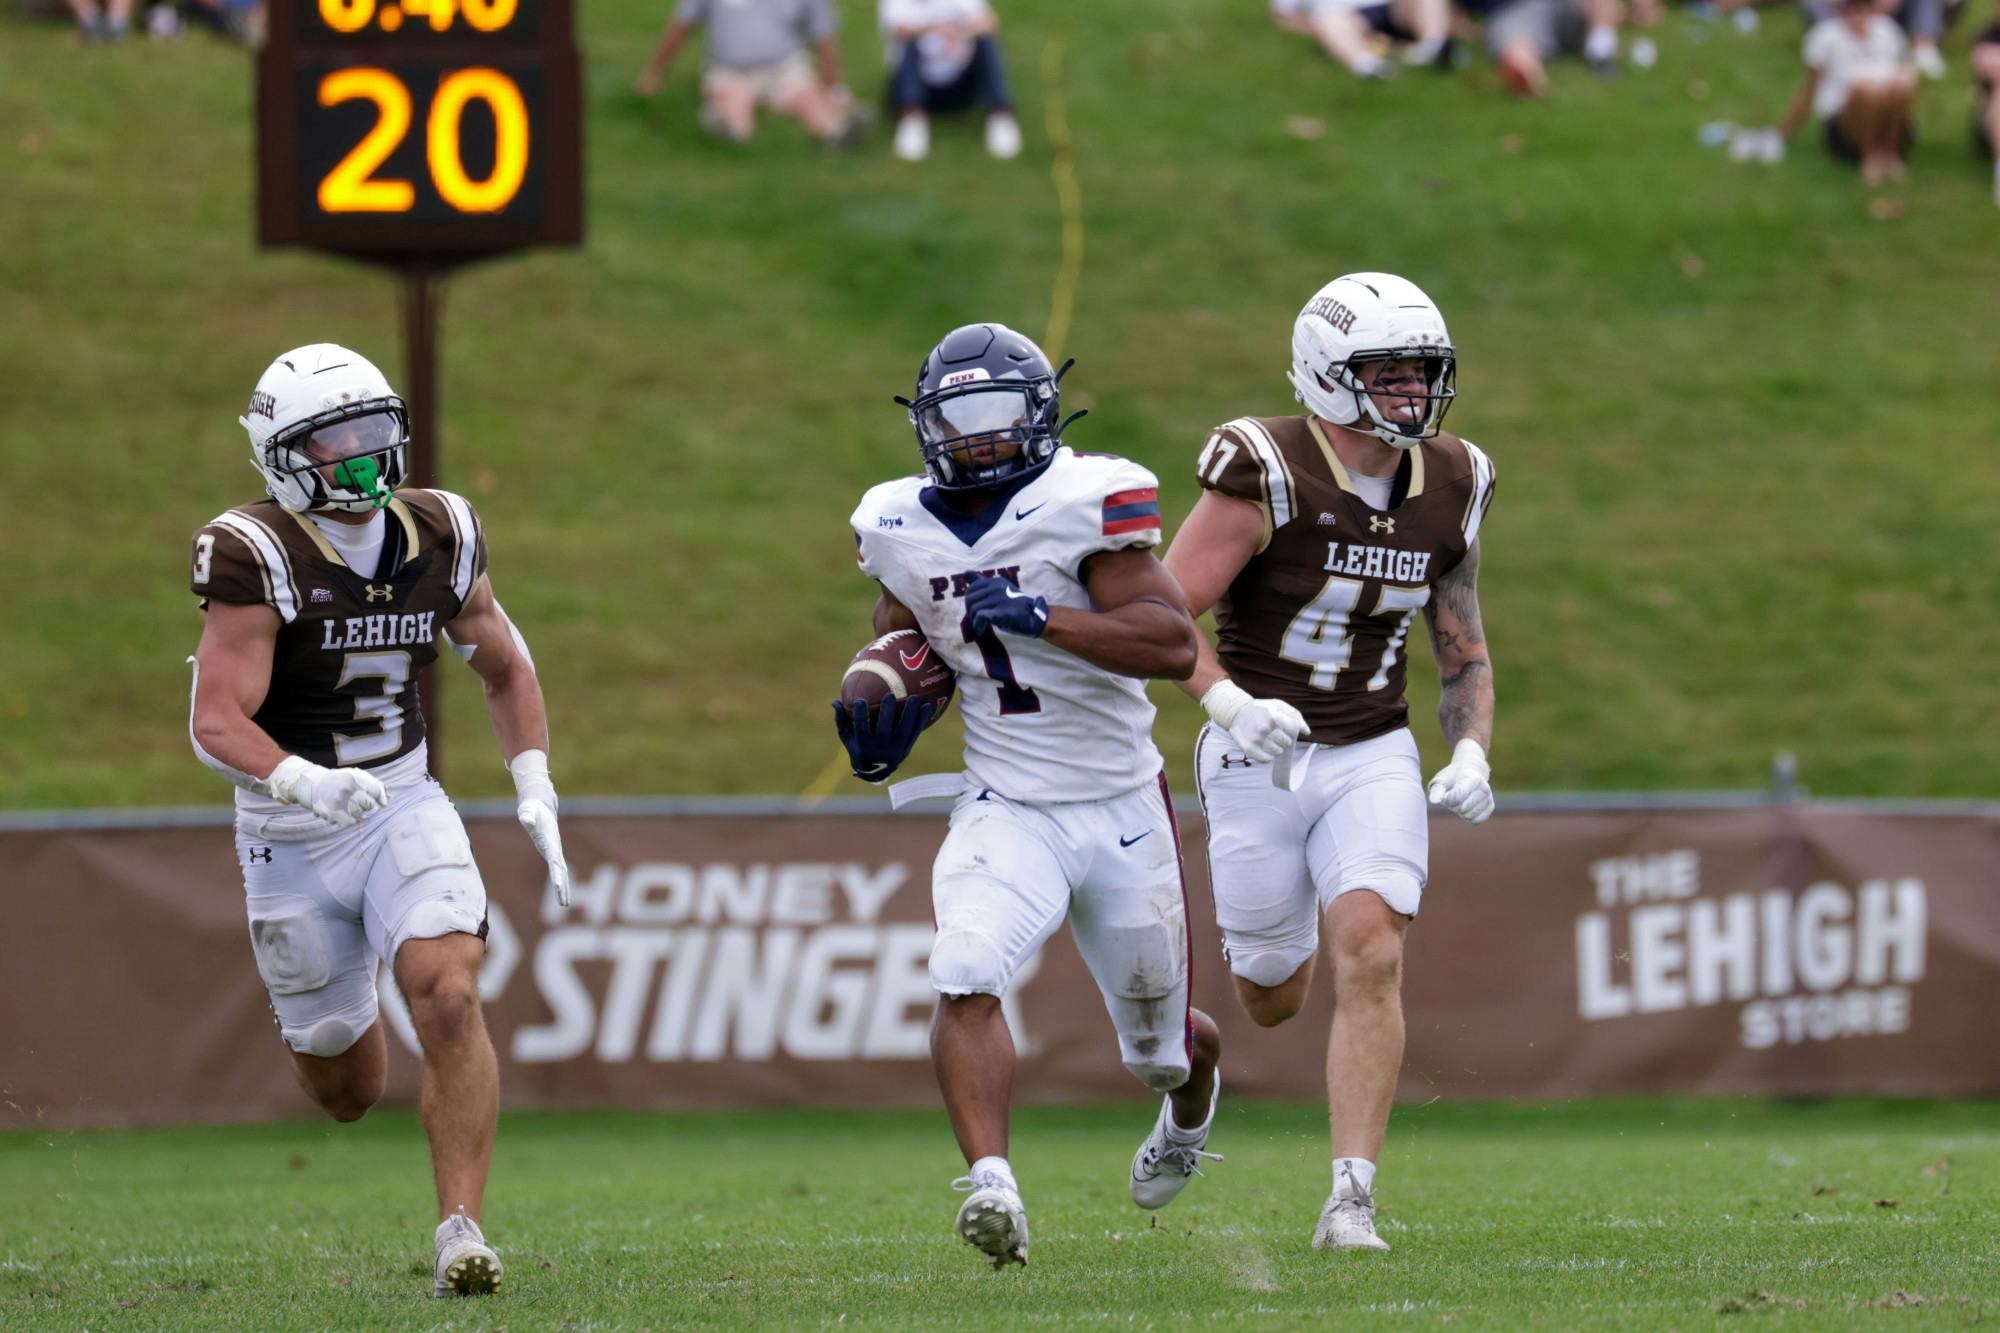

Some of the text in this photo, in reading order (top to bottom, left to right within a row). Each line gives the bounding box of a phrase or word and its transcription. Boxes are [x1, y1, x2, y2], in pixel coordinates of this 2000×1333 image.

[317, 66, 529, 213] 20
[949, 372, 975, 384] PENN
[1197, 433, 1239, 485] 47
[193, 533, 216, 584] 3
[1323, 541, 1431, 582] LEHIGH
[320, 610, 435, 650] LEHIGH
[1278, 575, 1431, 692] 47
[960, 612, 1041, 715] 1
[331, 650, 412, 766] 3
[540, 862, 911, 926] HONEY
[1591, 849, 1698, 906] THE
[1575, 877, 1928, 1020] LEHIGH
[512, 924, 1042, 1063] STINGE
[1740, 987, 1912, 1048] STORE
